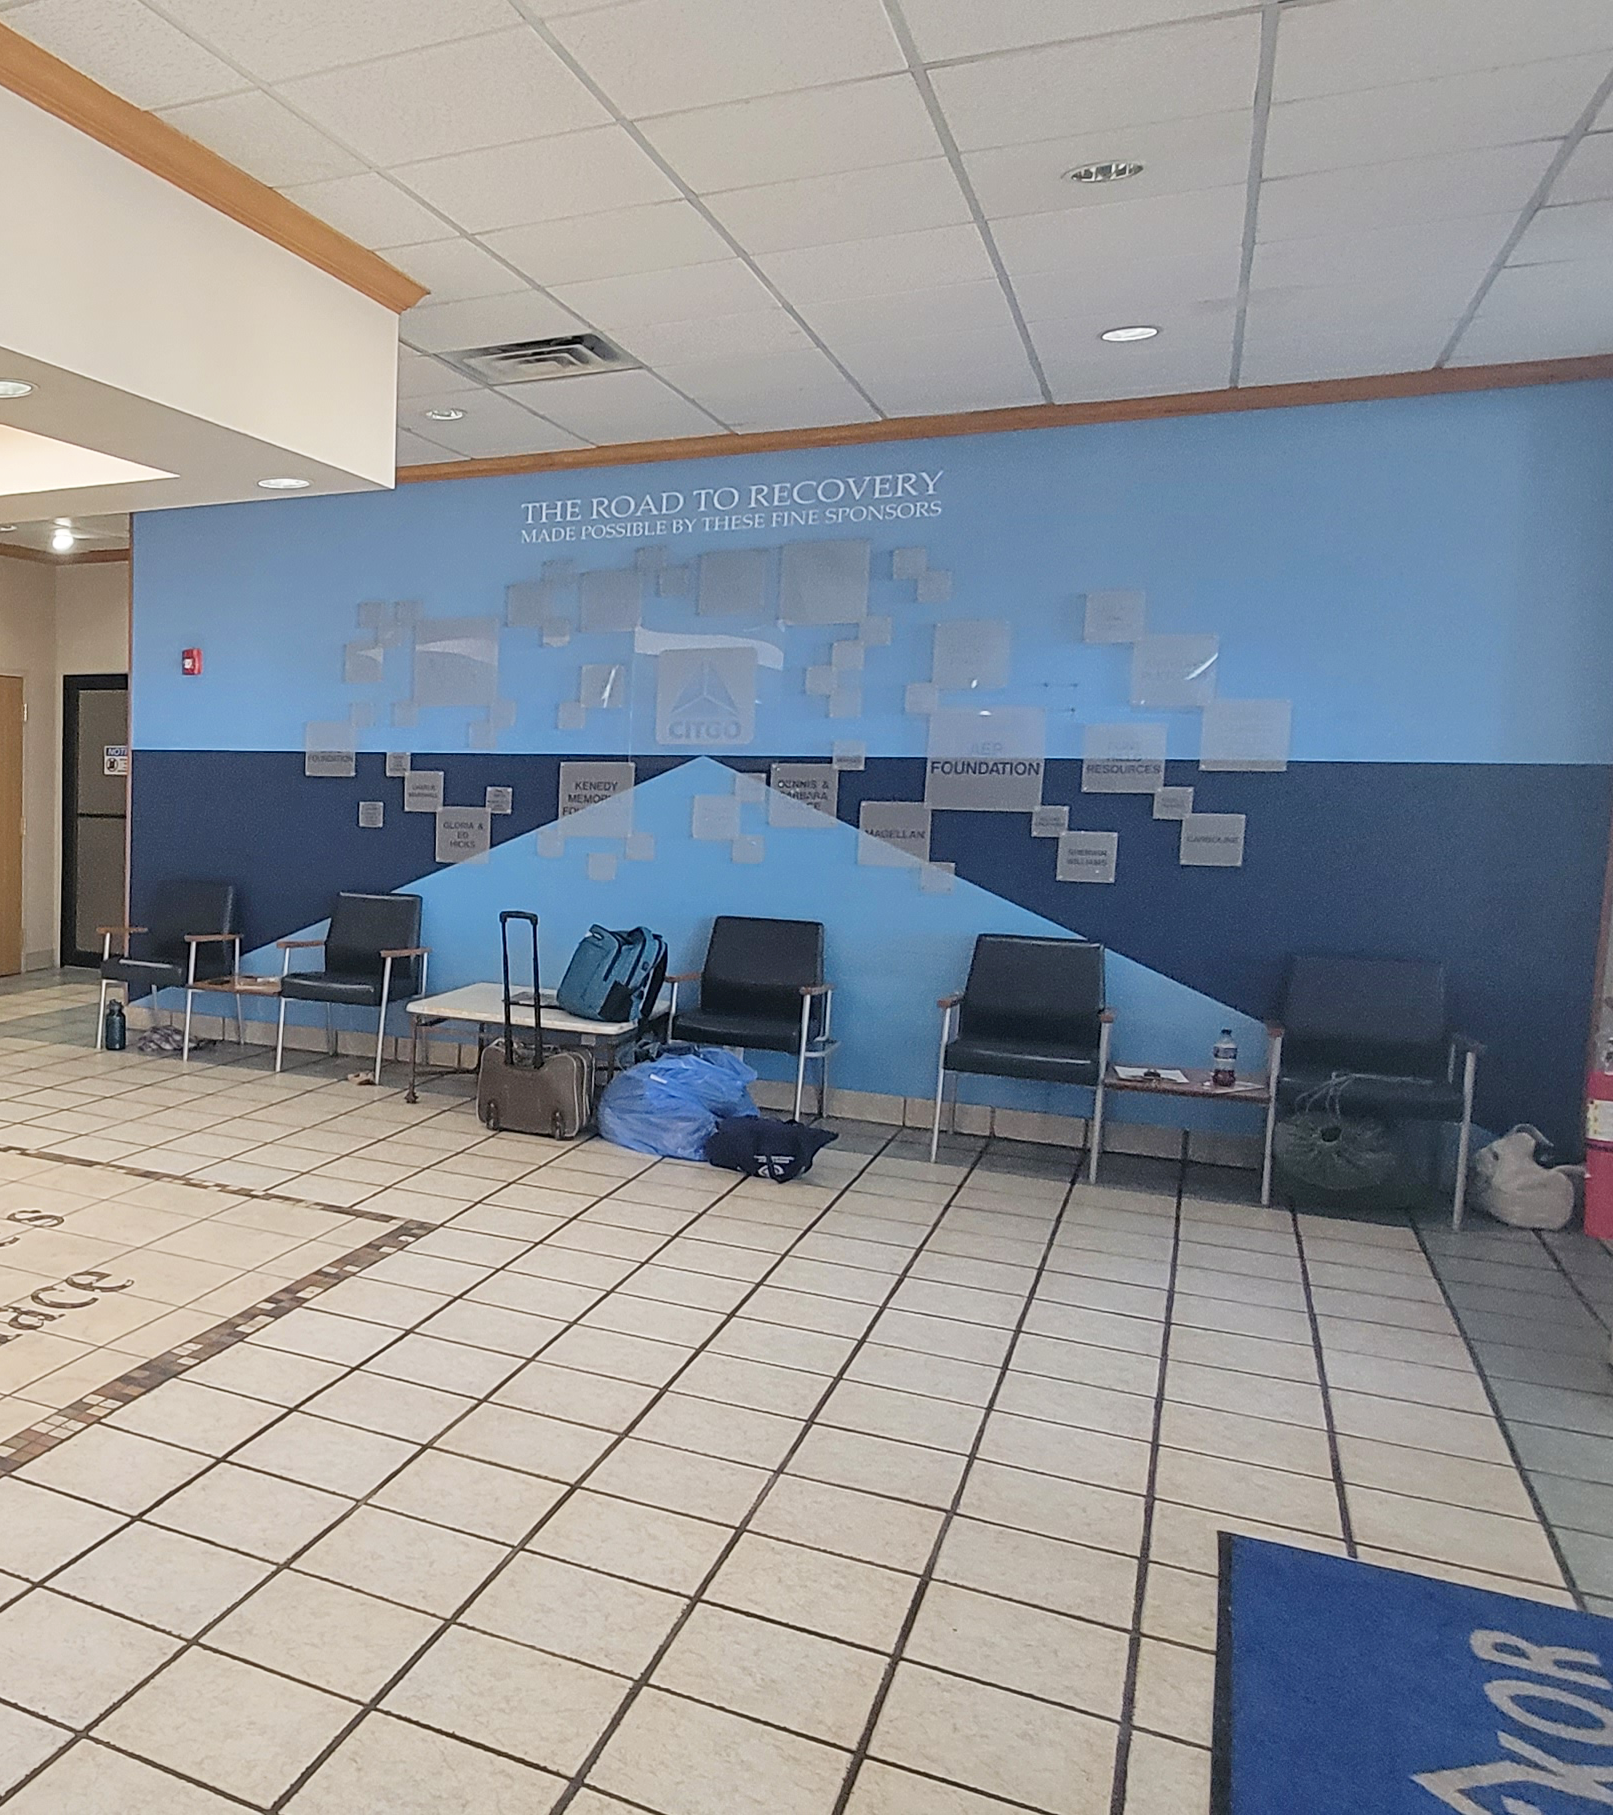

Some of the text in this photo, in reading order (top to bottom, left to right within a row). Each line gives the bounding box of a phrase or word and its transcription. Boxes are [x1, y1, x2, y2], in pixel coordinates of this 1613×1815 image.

[521, 470, 944, 524] THE ROAD TO RECOVERY
[521, 500, 943, 544] MADE POSSIBLE BY THESE FINE SPONSORS
[668, 720, 742, 740] CITGO
[107, 748, 127, 756] NOTI
[930, 760, 1042, 777] FOUNDATION
[1086, 764, 1162, 775] RESOURCES
[574, 781, 618, 792] KENEDY
[568, 793, 611, 804] MEMOR
